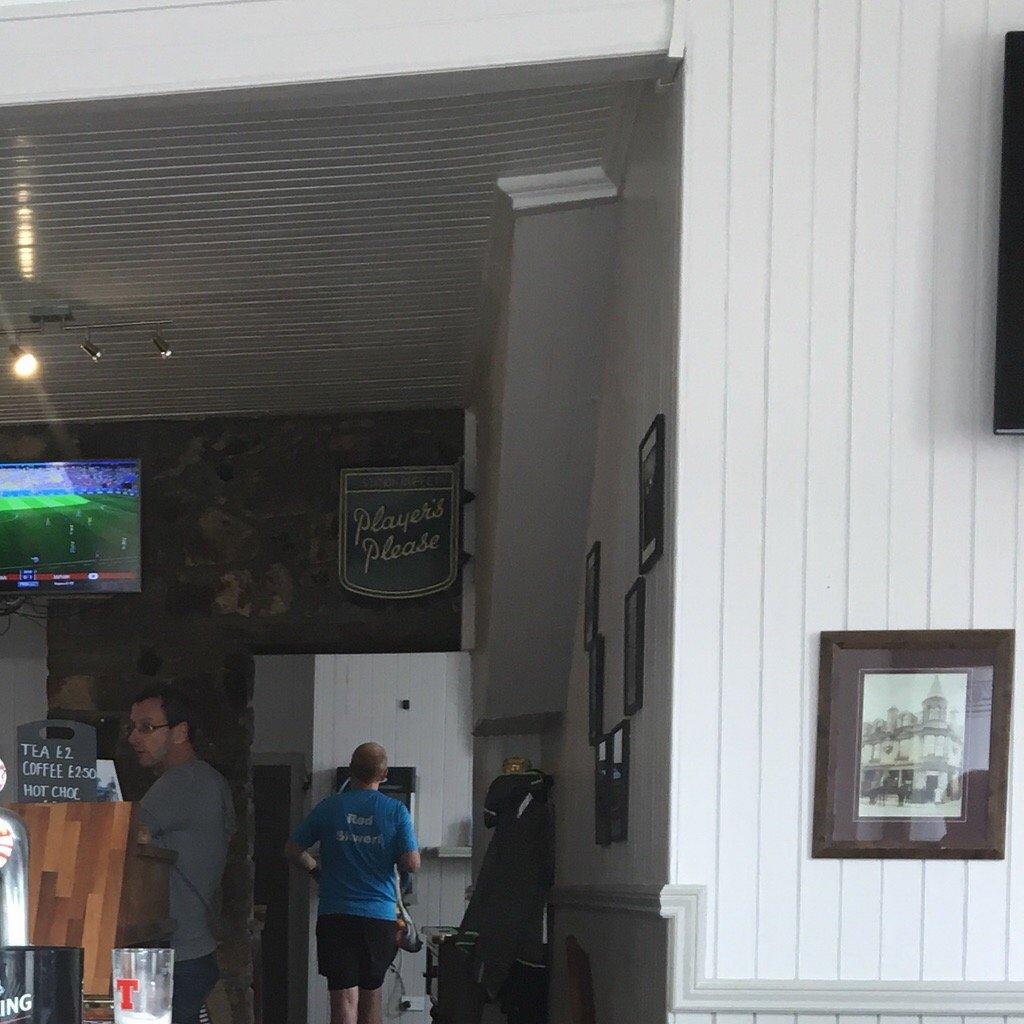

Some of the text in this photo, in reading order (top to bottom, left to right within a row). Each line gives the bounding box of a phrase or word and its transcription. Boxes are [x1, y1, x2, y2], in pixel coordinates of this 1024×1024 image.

[353, 497, 446, 546] Player's
[361, 531, 441, 574] Please
[20, 743, 50, 759] TEA
[22, 760, 64, 779] COFFEE
[23, 783, 81, 801] HOT CHOC
[116, 978, 139, 1011] T
